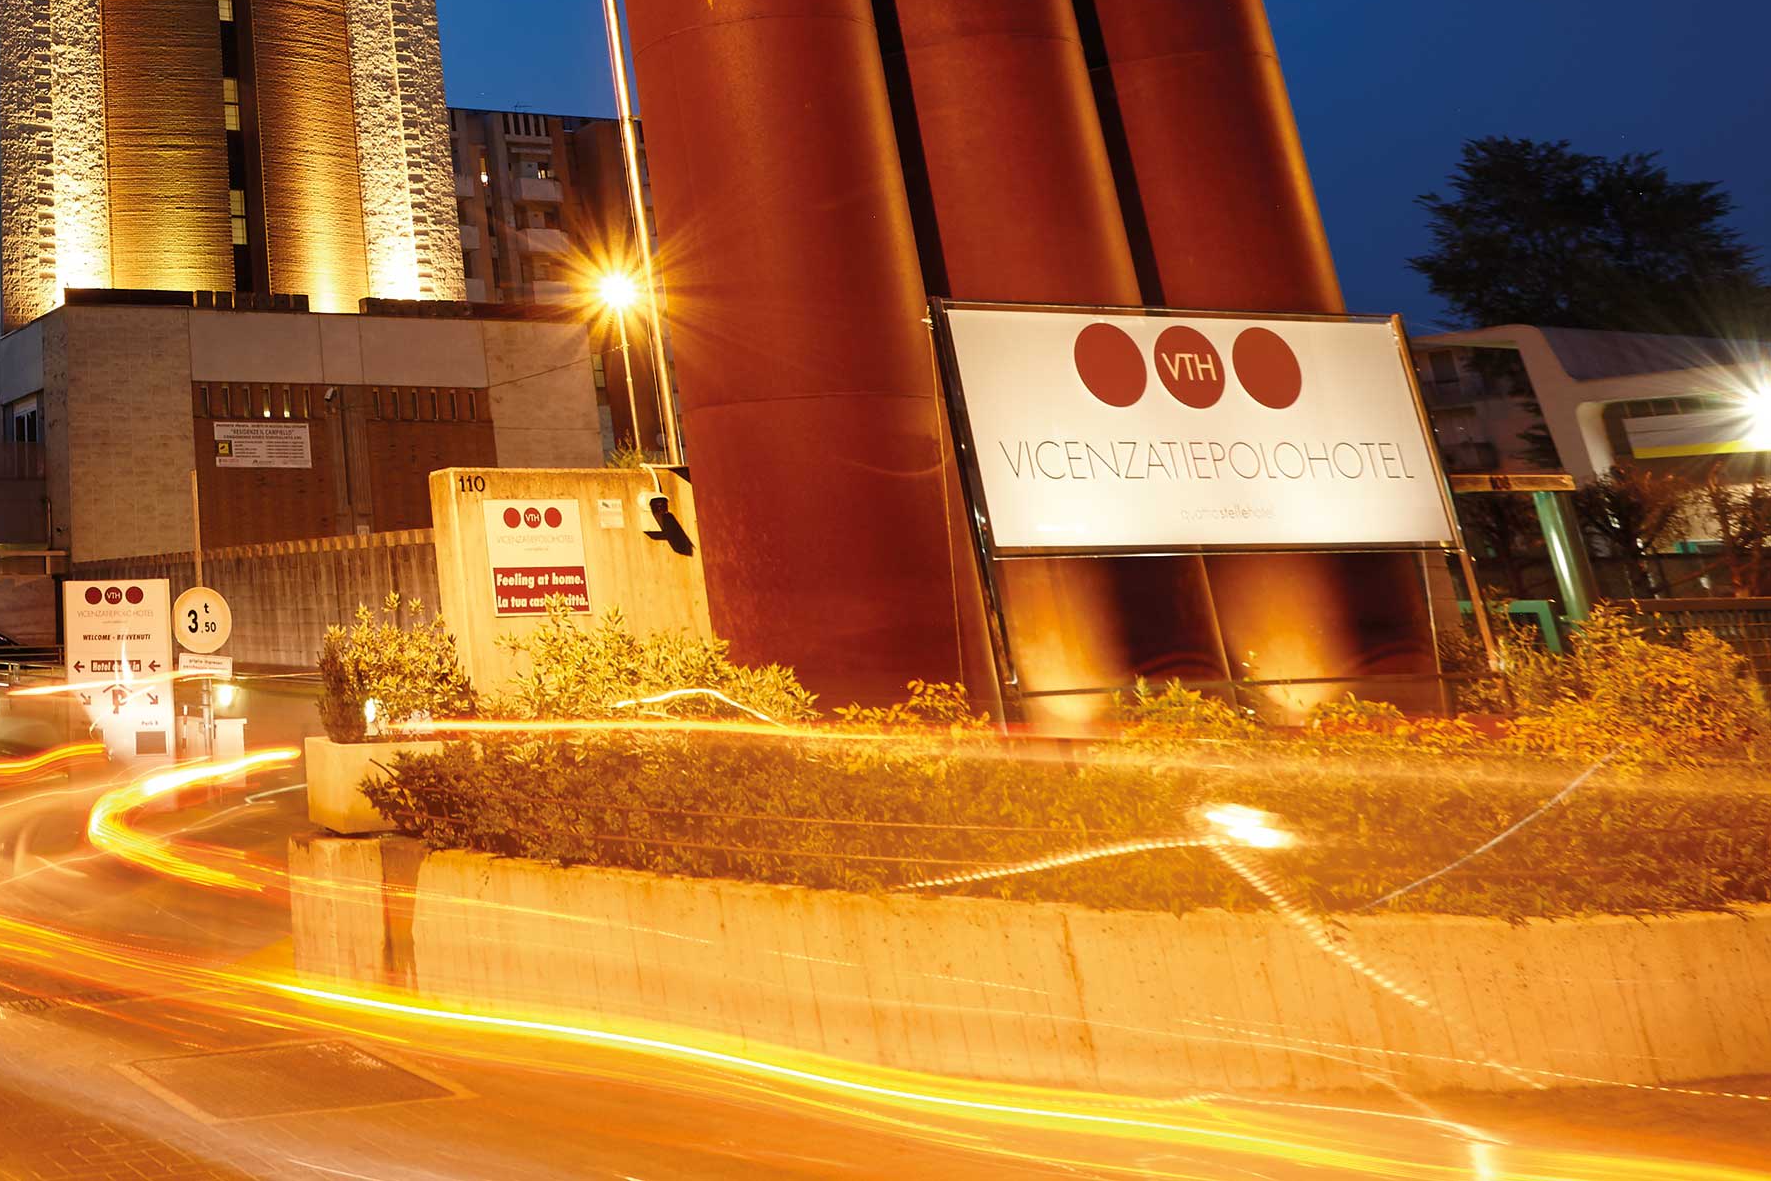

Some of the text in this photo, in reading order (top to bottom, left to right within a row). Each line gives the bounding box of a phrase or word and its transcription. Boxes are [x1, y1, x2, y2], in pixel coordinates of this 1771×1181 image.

[1160, 352, 1219, 381] VTH
[998, 440, 1415, 480] VICENZATIEPOLOHOTEL
[459, 474, 485, 492] 110
[525, 513, 540, 522] VTH
[496, 572, 584, 589] Feeling at home.
[203, 602, 210, 614] t
[497, 595, 508, 608] La
[511, 596, 527, 607] tua
[529, 597, 550, 607] cas
[92, 661, 111, 672] Hotel
